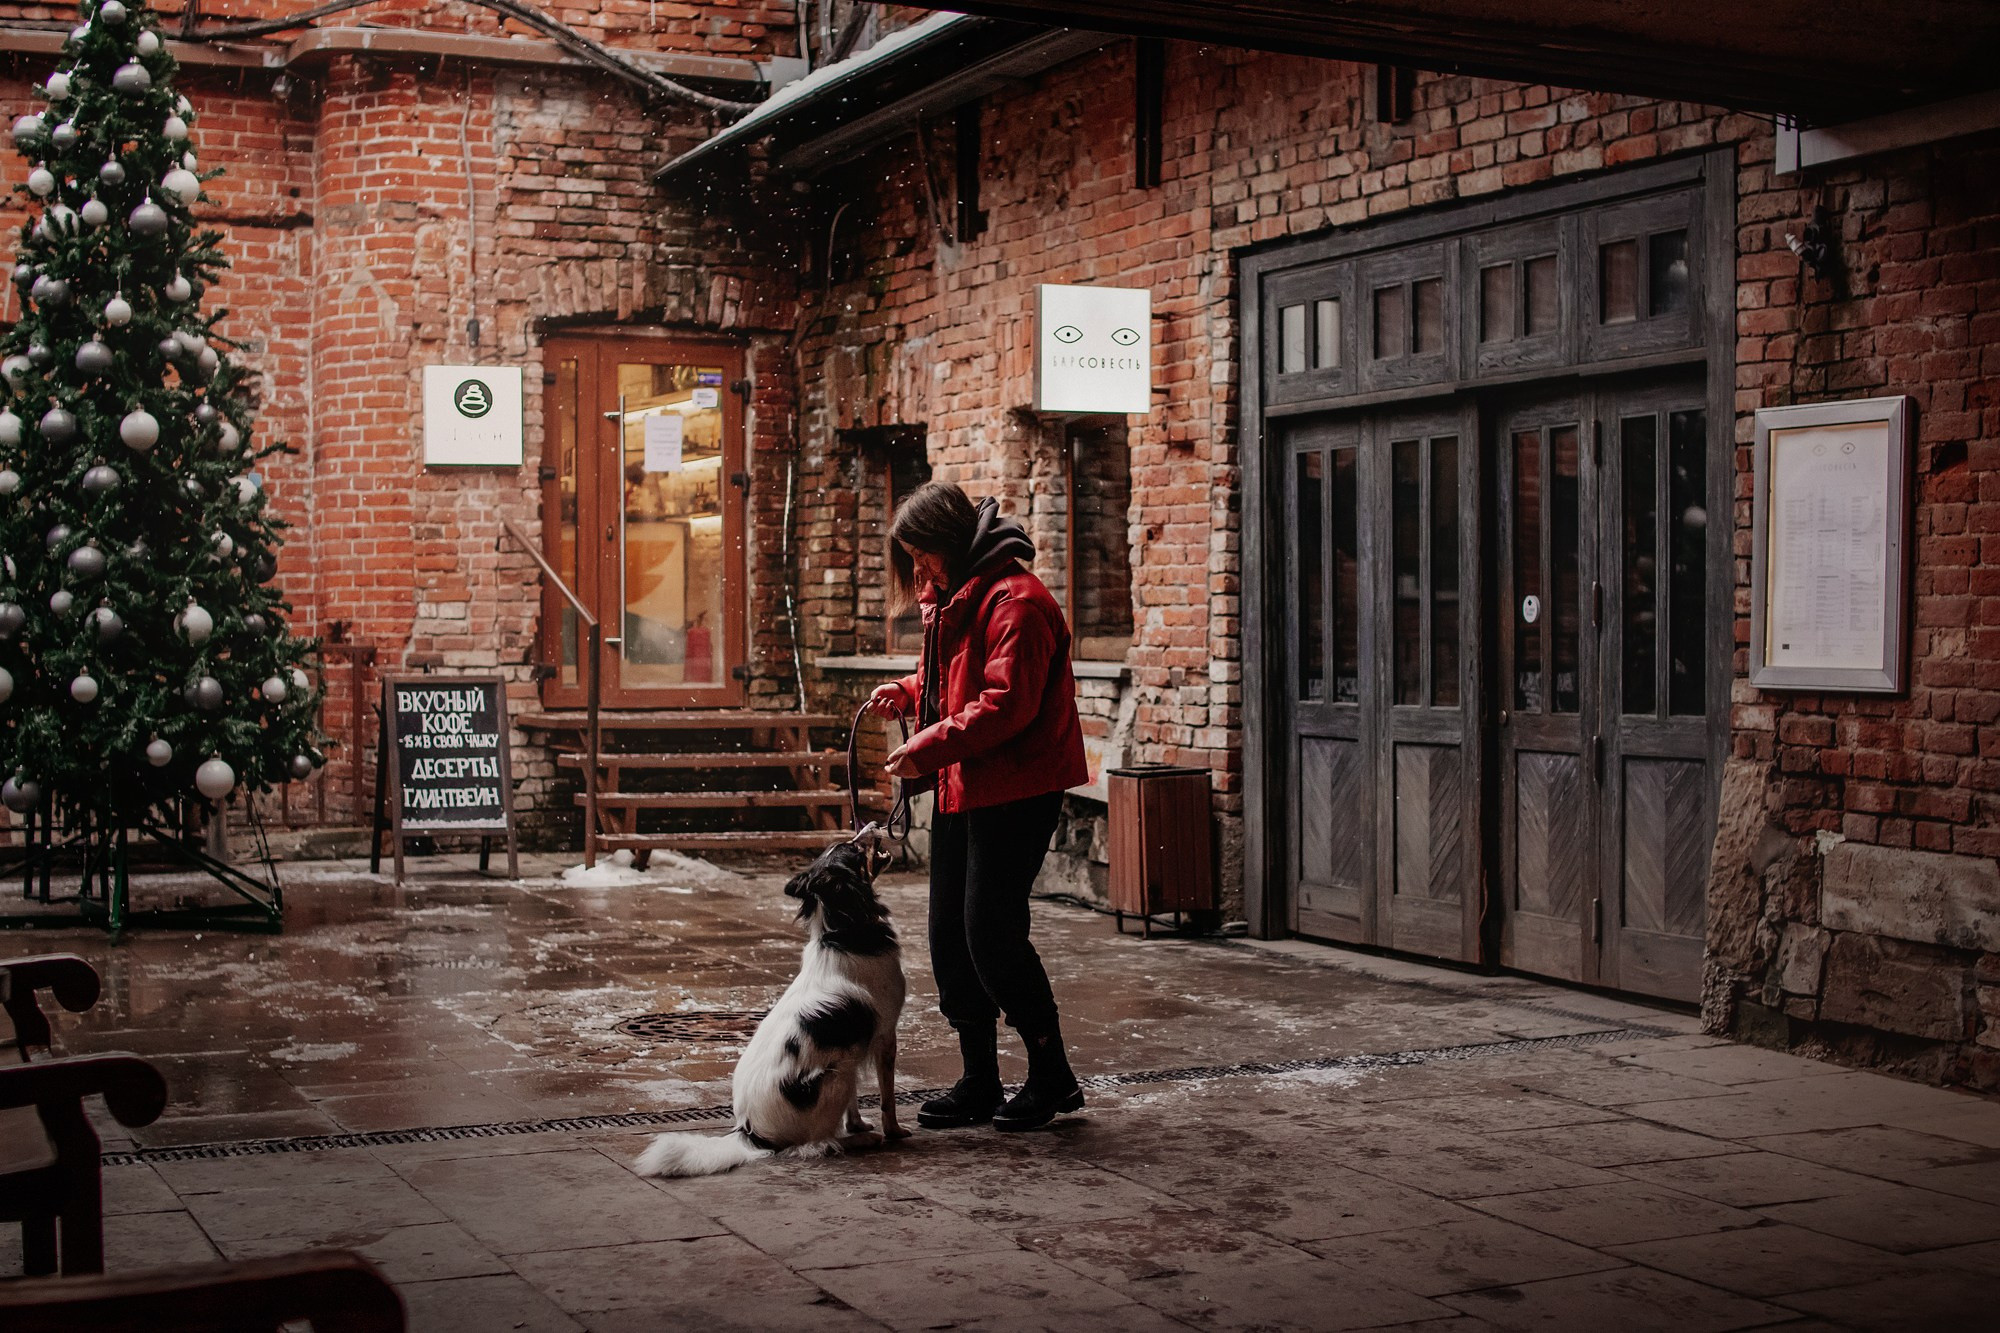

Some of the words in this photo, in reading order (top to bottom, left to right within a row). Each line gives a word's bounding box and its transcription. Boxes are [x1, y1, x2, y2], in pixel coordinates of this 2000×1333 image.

[397, 687, 485, 712] ВКУСНЫЙ
[422, 712, 473, 734] КОФЕ
[422, 734, 431, 749] В
[433, 734, 463, 749] СВОЮ
[464, 733, 499, 749] ЧАШКУ
[411, 756, 500, 781] ДЕСЕРТЫ
[403, 784, 500, 808] ГЛИНТВЕЙН
